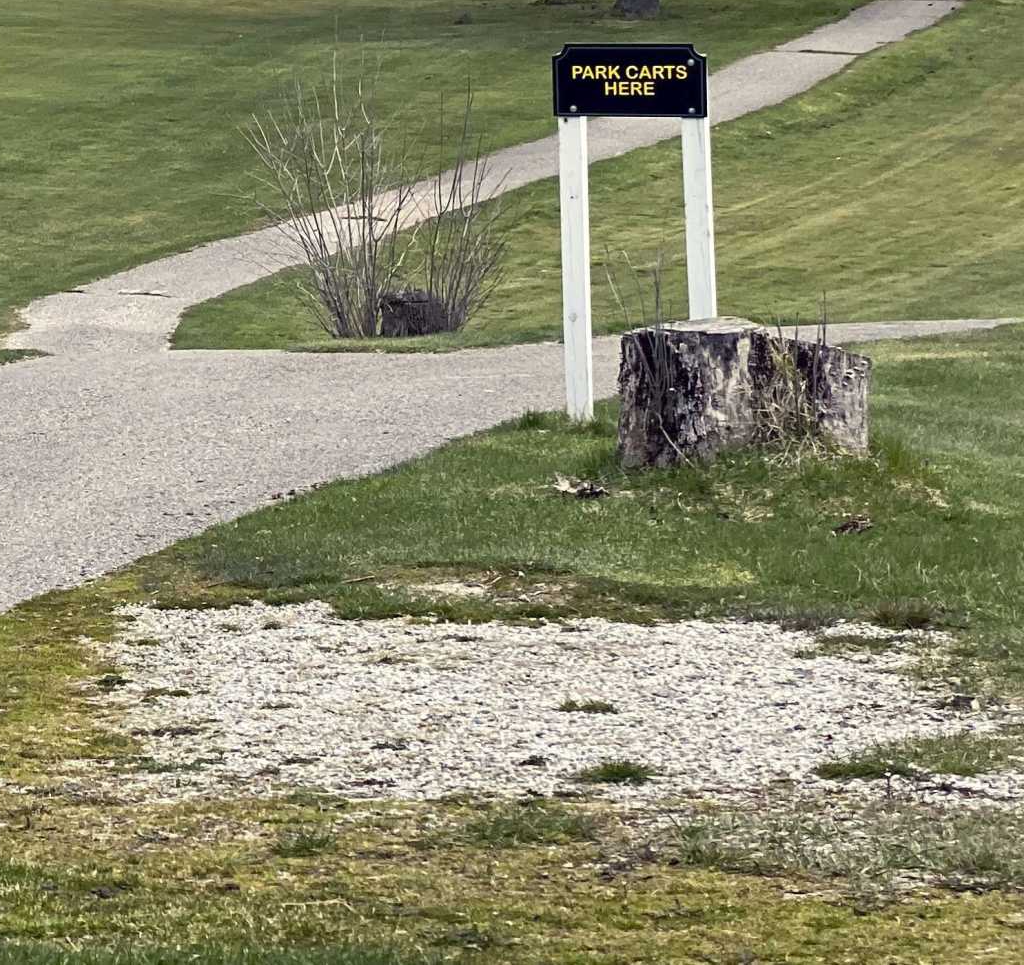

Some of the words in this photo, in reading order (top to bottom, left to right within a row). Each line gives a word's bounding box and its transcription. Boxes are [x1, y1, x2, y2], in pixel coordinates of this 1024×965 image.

[571, 65, 621, 80] PARK
[625, 65, 688, 80] CARTS
[604, 81, 656, 96] HERE
